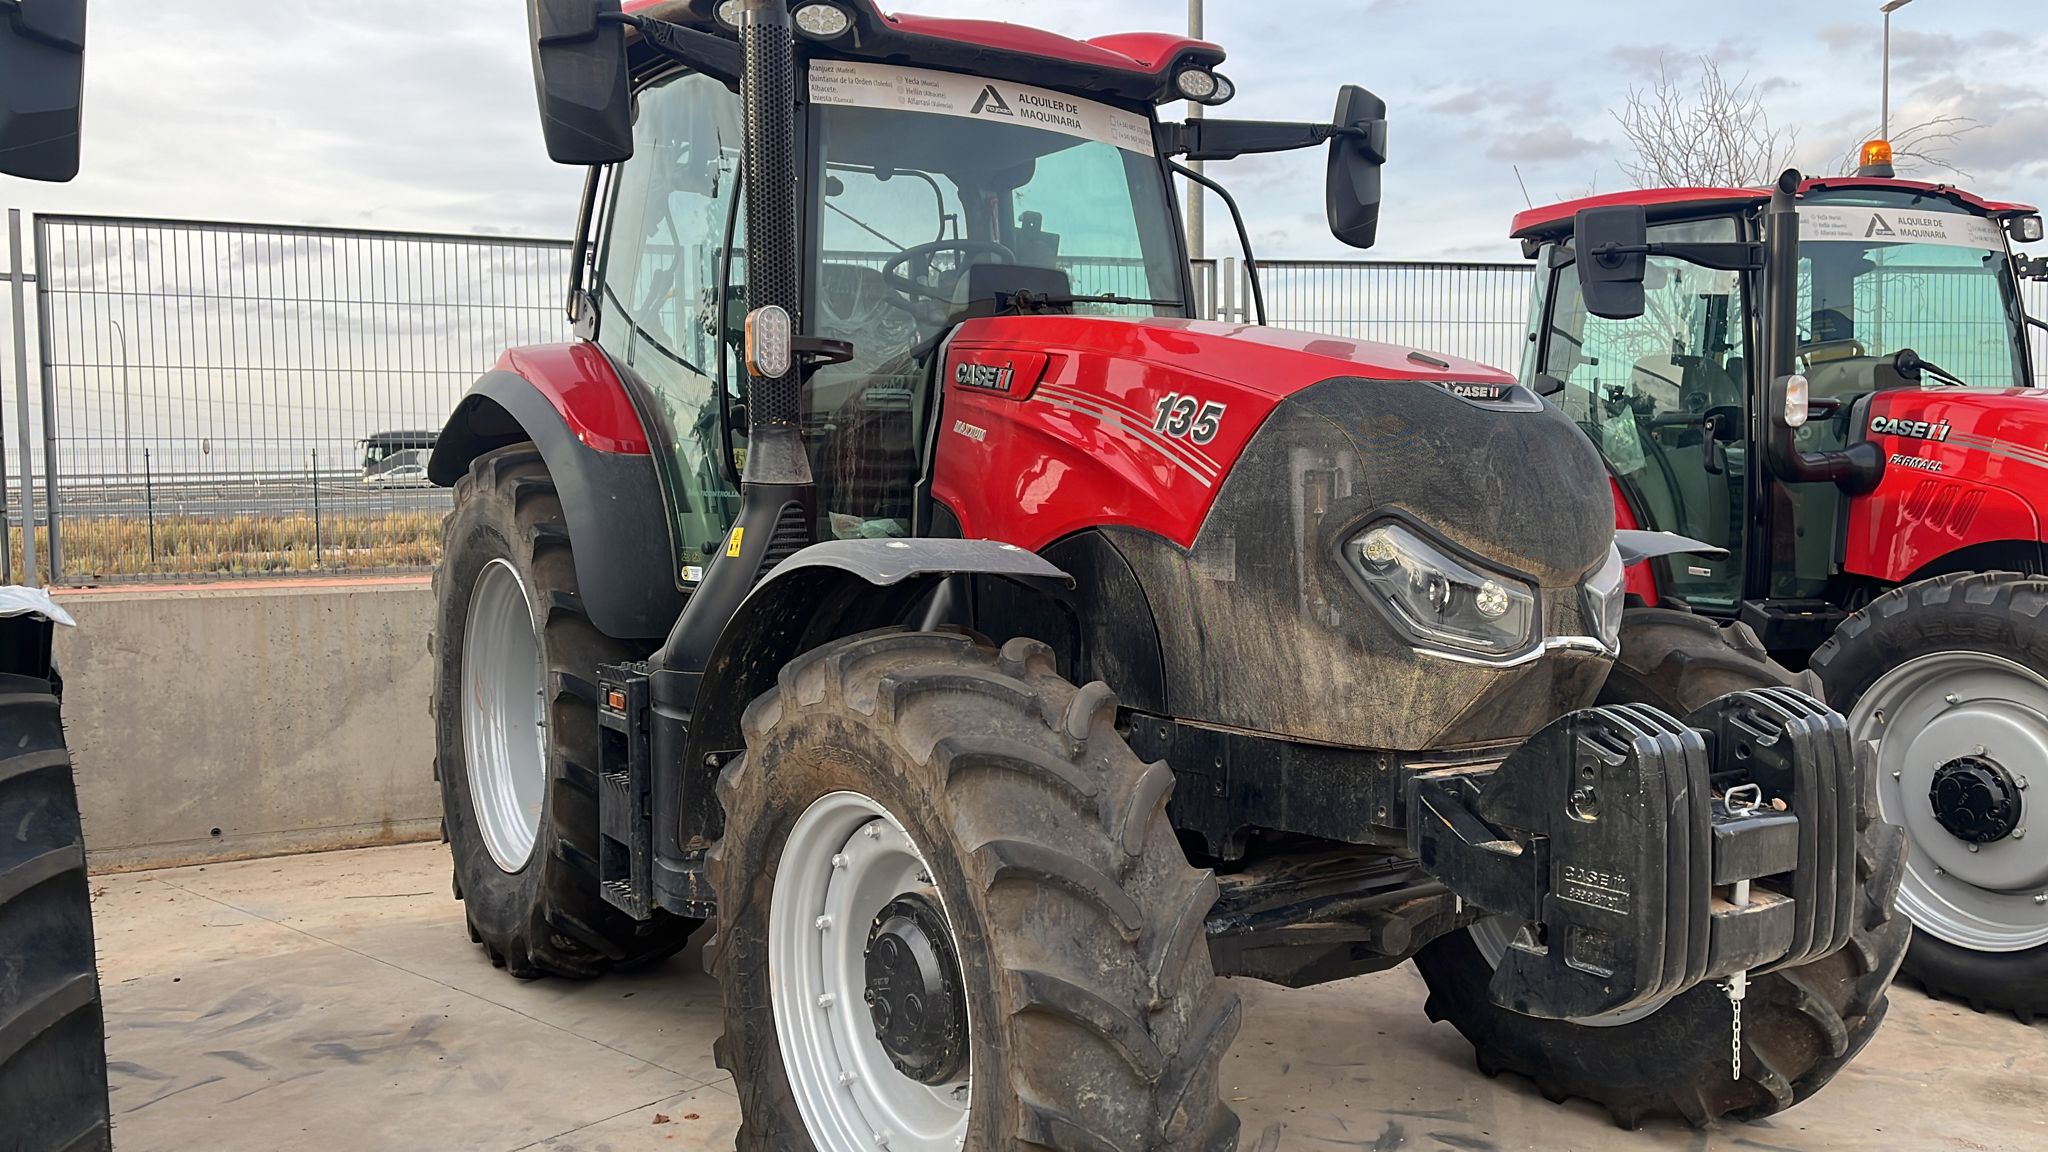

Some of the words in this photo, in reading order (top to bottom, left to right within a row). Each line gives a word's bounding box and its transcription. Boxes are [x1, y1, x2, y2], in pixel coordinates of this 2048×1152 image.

[840, 76, 847, 84] de
[855, 77, 872, 87] Orden
[1018, 93, 1065, 112] ALQUILER
[1066, 103, 1078, 115] DE
[1020, 108, 1082, 130] MAQUINARIA
[1898, 217, 1932, 227] ALQUILER
[1933, 219, 1943, 228] DE
[1900, 228, 1947, 239] MAQUINARIA
[955, 362, 997, 387] CASE
[1454, 386, 1488, 398] CASE
[1153, 391, 1227, 446] 135
[1870, 416, 1928, 438] CASE
[1888, 453, 1943, 472] FARMALL
